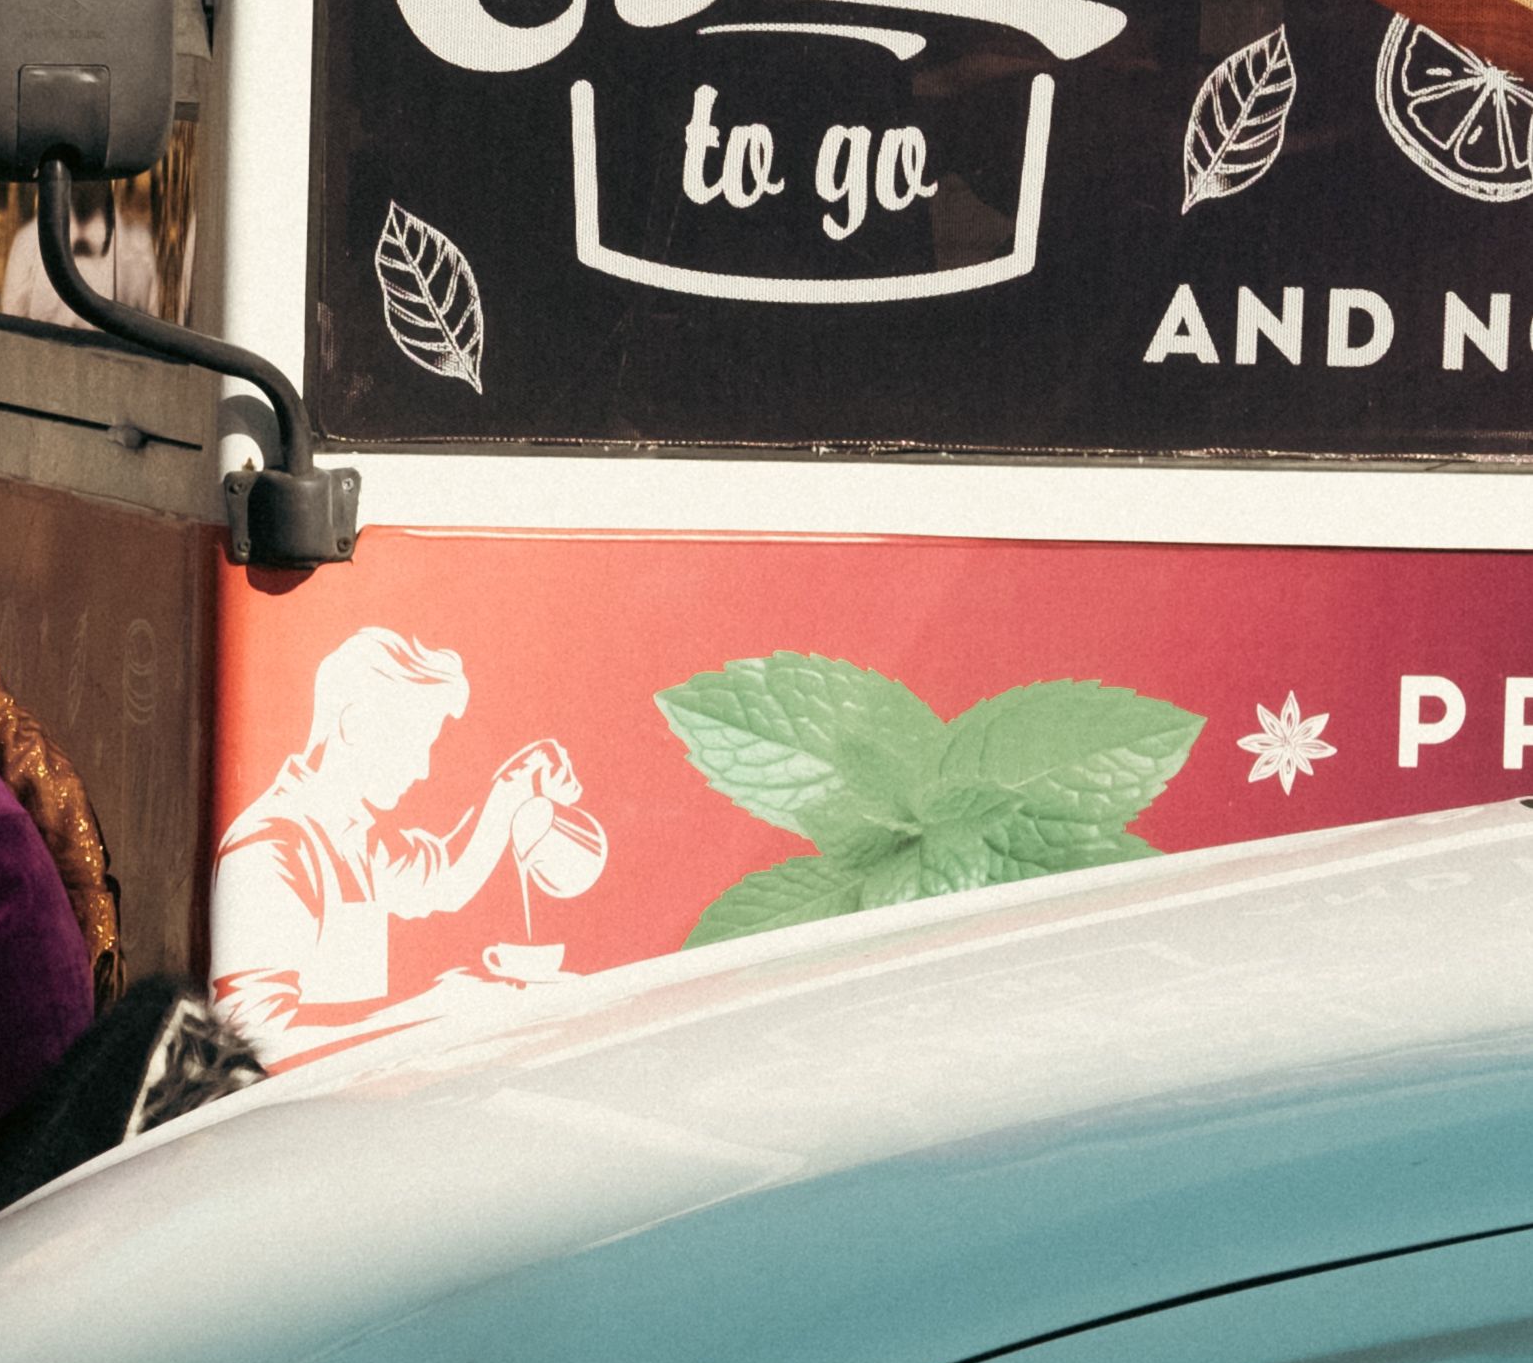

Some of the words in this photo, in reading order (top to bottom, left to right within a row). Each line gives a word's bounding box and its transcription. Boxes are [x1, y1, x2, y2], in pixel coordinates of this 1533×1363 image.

[682, 84, 785, 209] to
[814, 124, 939, 242] go
[1143, 283, 1396, 368] AND
[1442, 291, 1533, 372] N
